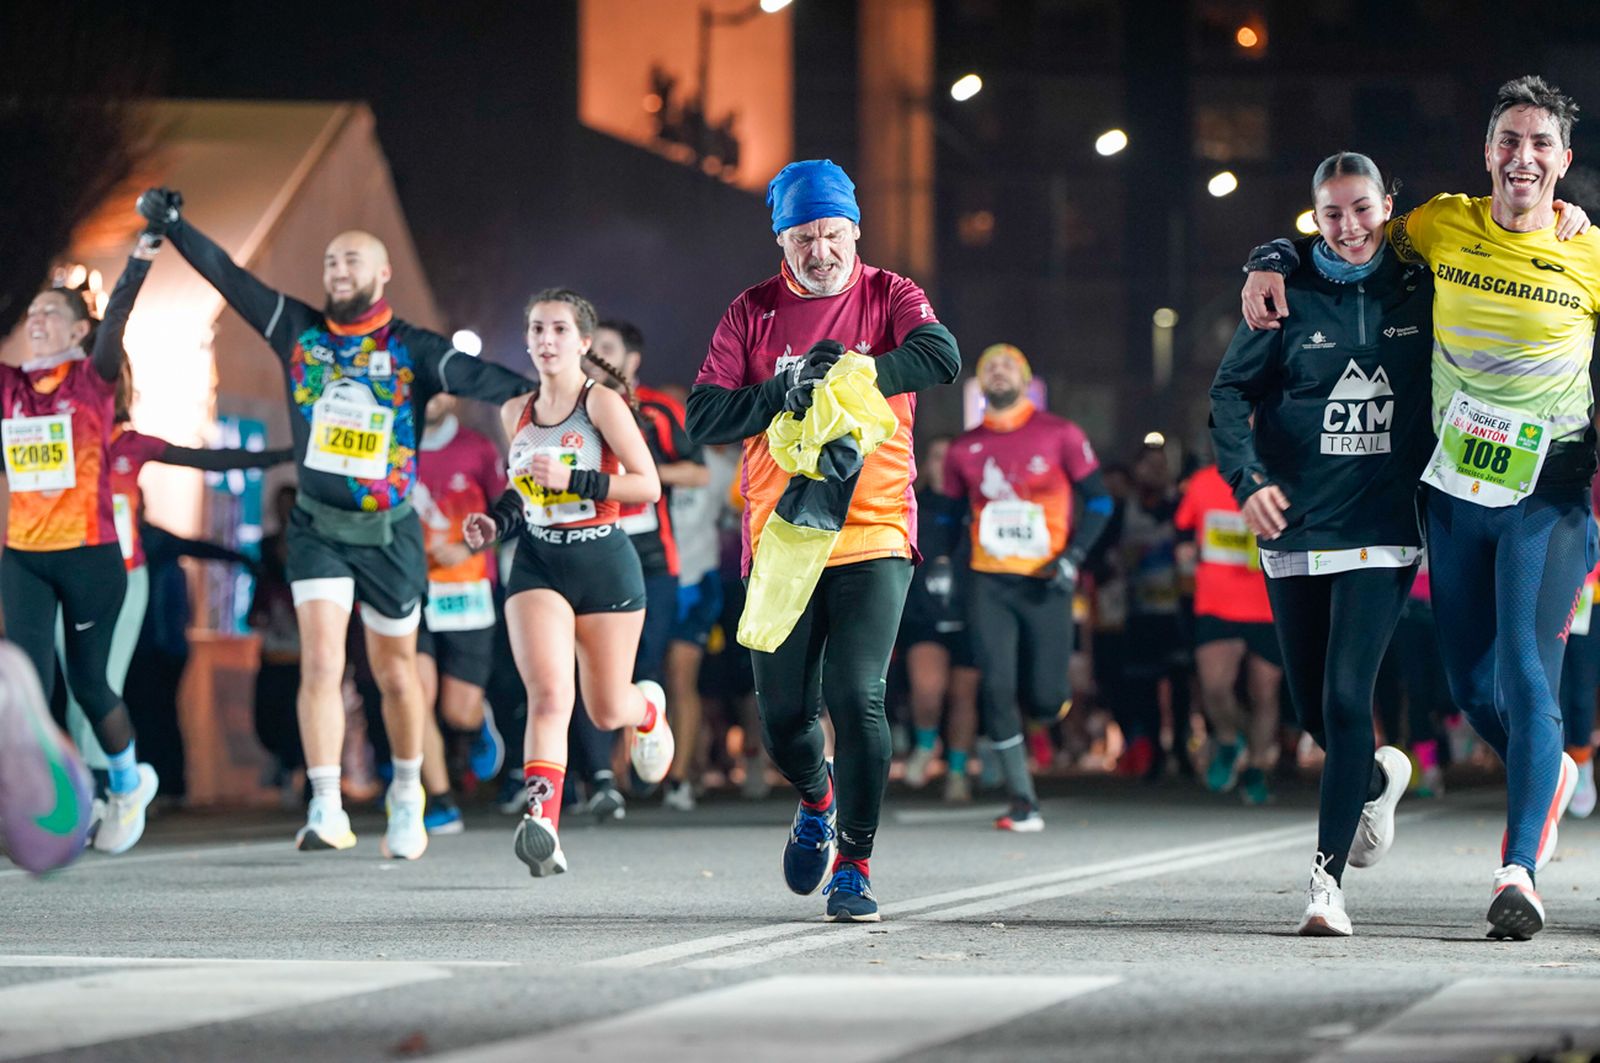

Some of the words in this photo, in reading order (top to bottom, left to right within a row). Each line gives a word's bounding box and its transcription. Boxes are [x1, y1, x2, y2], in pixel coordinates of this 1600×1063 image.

[1436, 263, 1581, 310] ENMASCARADOS
[1322, 400, 1394, 432] CXM
[1468, 411, 1498, 428] NOCHE
[1497, 421, 1512, 432] DE
[324, 427, 377, 452] 12610
[1327, 436, 1385, 452] TRAIL
[12, 443, 63, 465] 12085
[1462, 437, 1512, 475] 108
[566, 524, 612, 544] PRO
